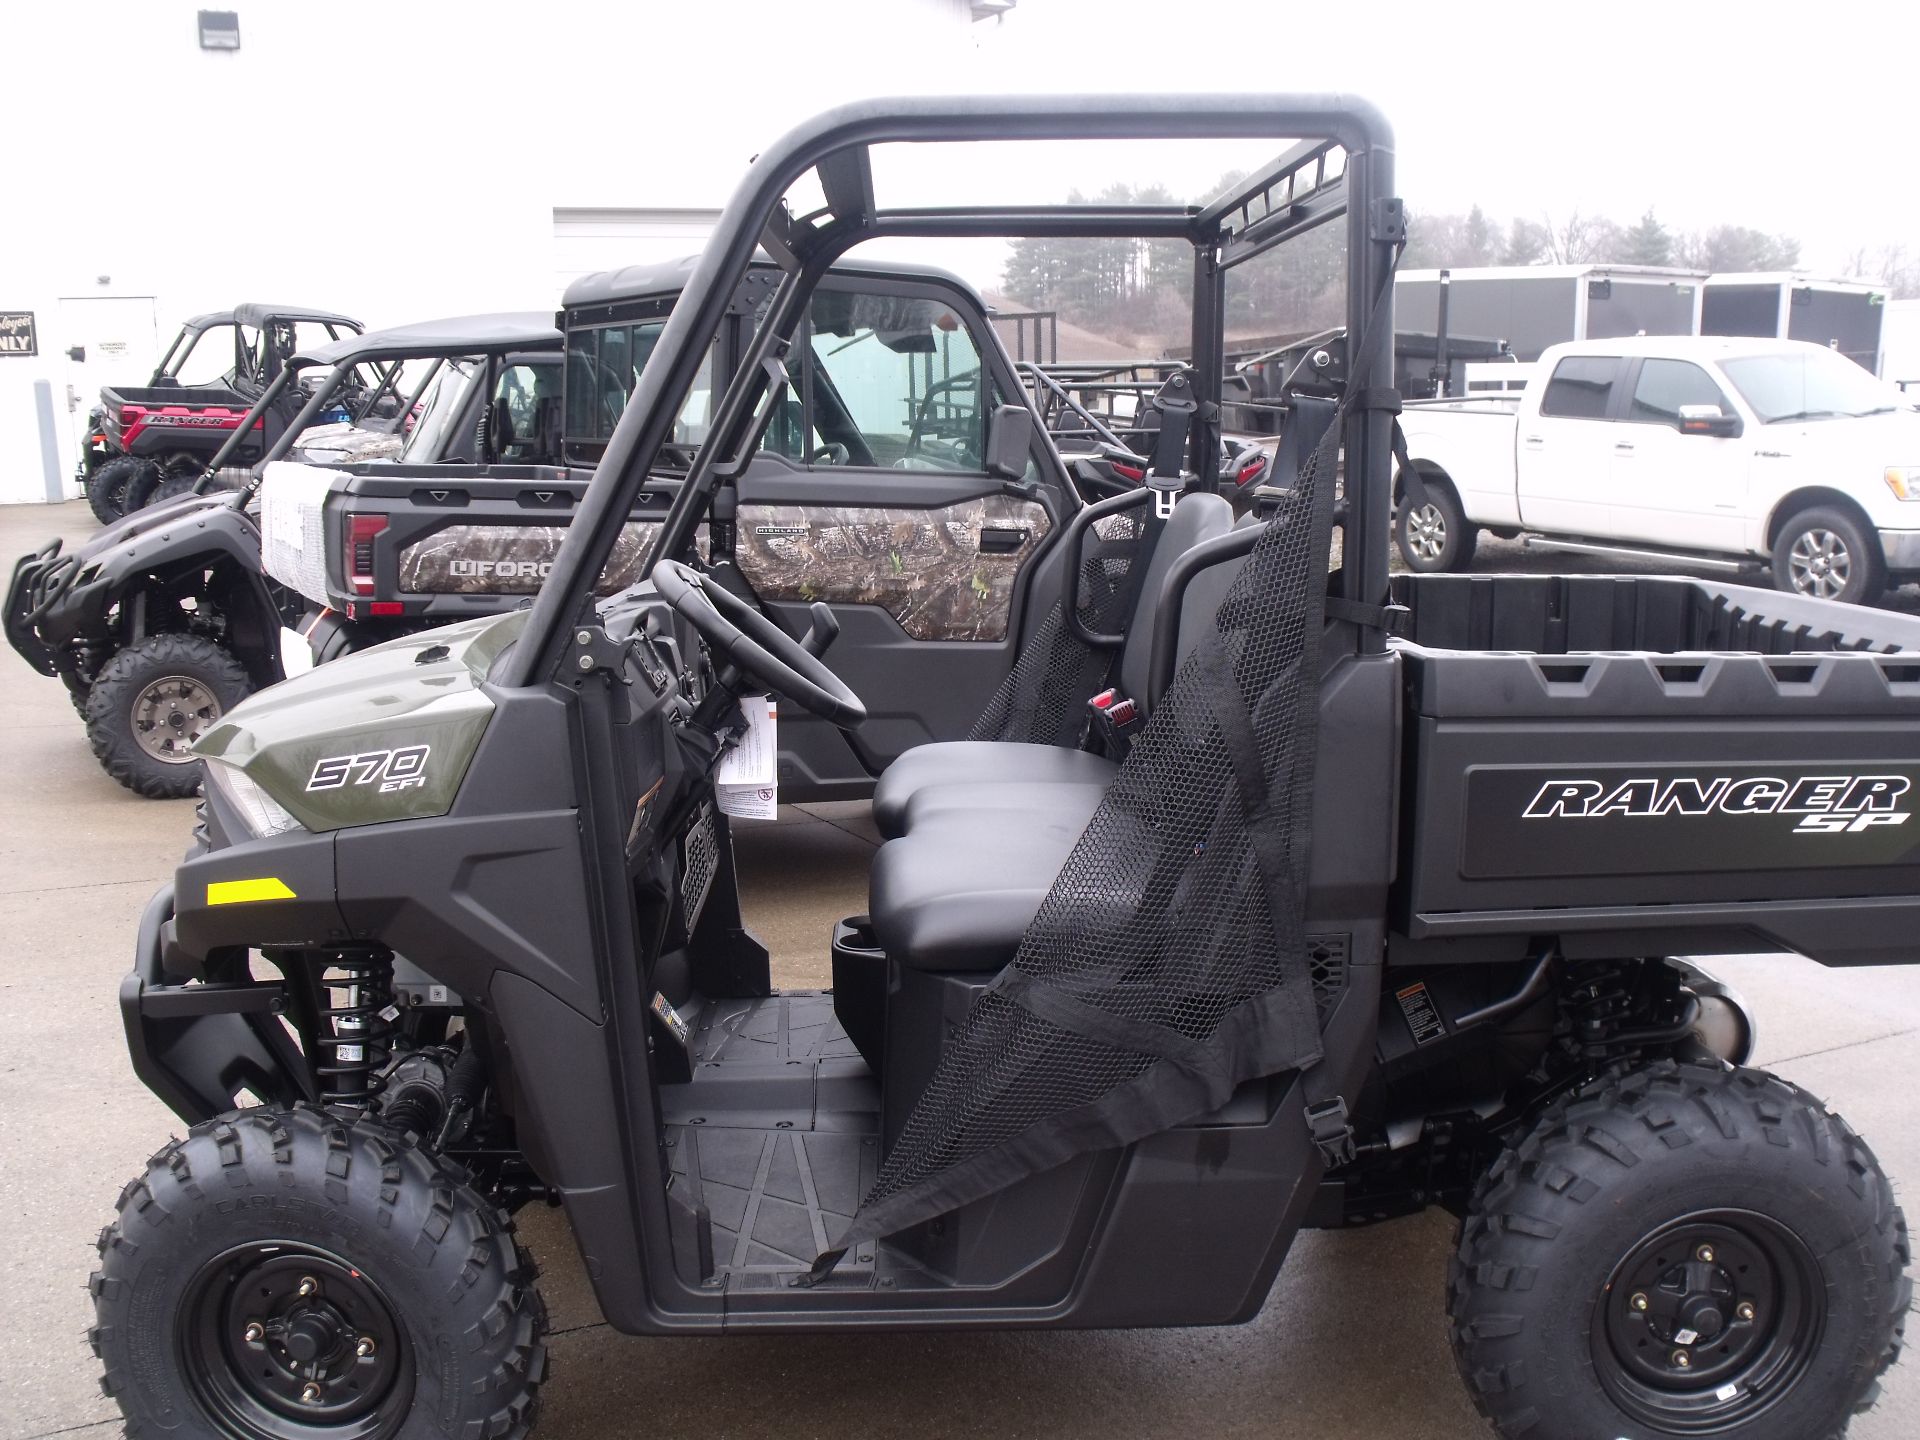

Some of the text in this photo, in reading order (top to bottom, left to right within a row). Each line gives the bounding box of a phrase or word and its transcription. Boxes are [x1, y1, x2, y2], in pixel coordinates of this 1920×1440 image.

[0, 315, 32, 334] loyees
[151, 416, 224, 425] RANGER
[450, 560, 553, 577] UFORC
[305, 744, 430, 792] 570
[378, 776, 426, 793] EFI
[1521, 775, 1911, 818] RANGER
[1792, 812, 1911, 833] SP
[215, 1193, 362, 1235] CARLSTAR
